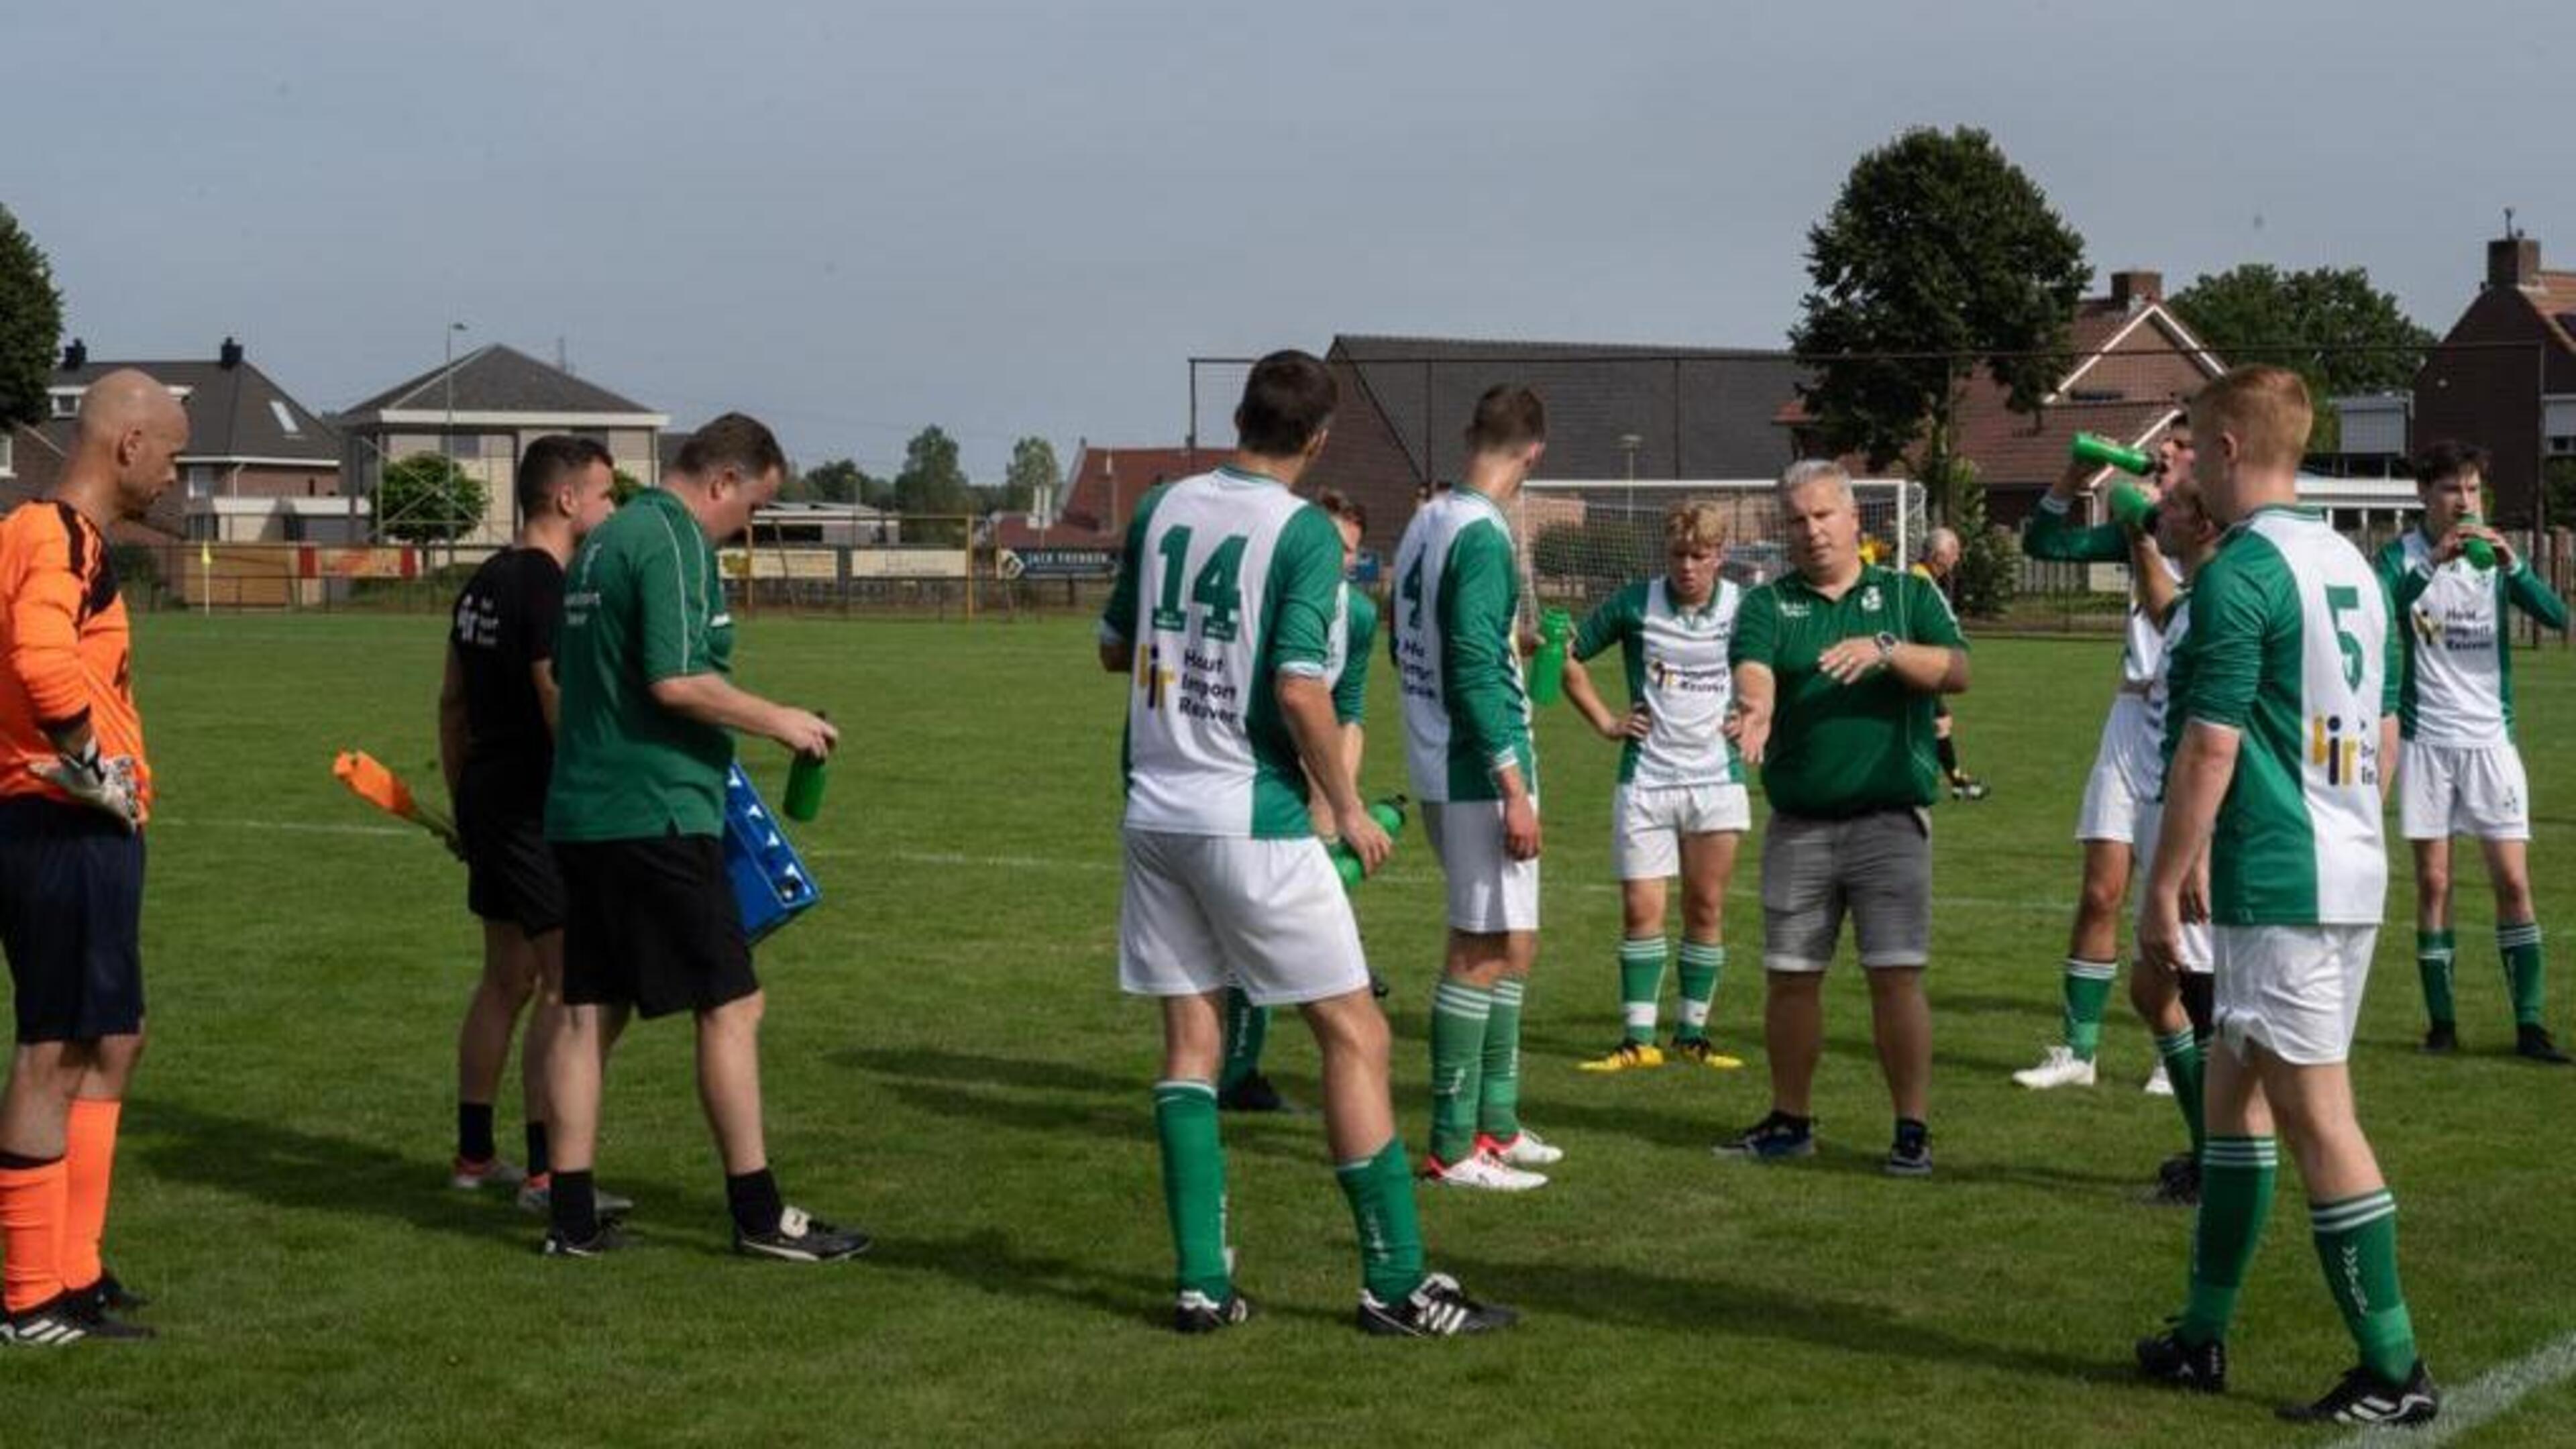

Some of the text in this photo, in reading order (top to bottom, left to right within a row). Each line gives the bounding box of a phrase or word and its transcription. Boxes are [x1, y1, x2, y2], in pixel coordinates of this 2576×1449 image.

[1152, 524, 1248, 643] 14
[1403, 542, 1426, 630] 4
[2325, 586, 2363, 694] 5
